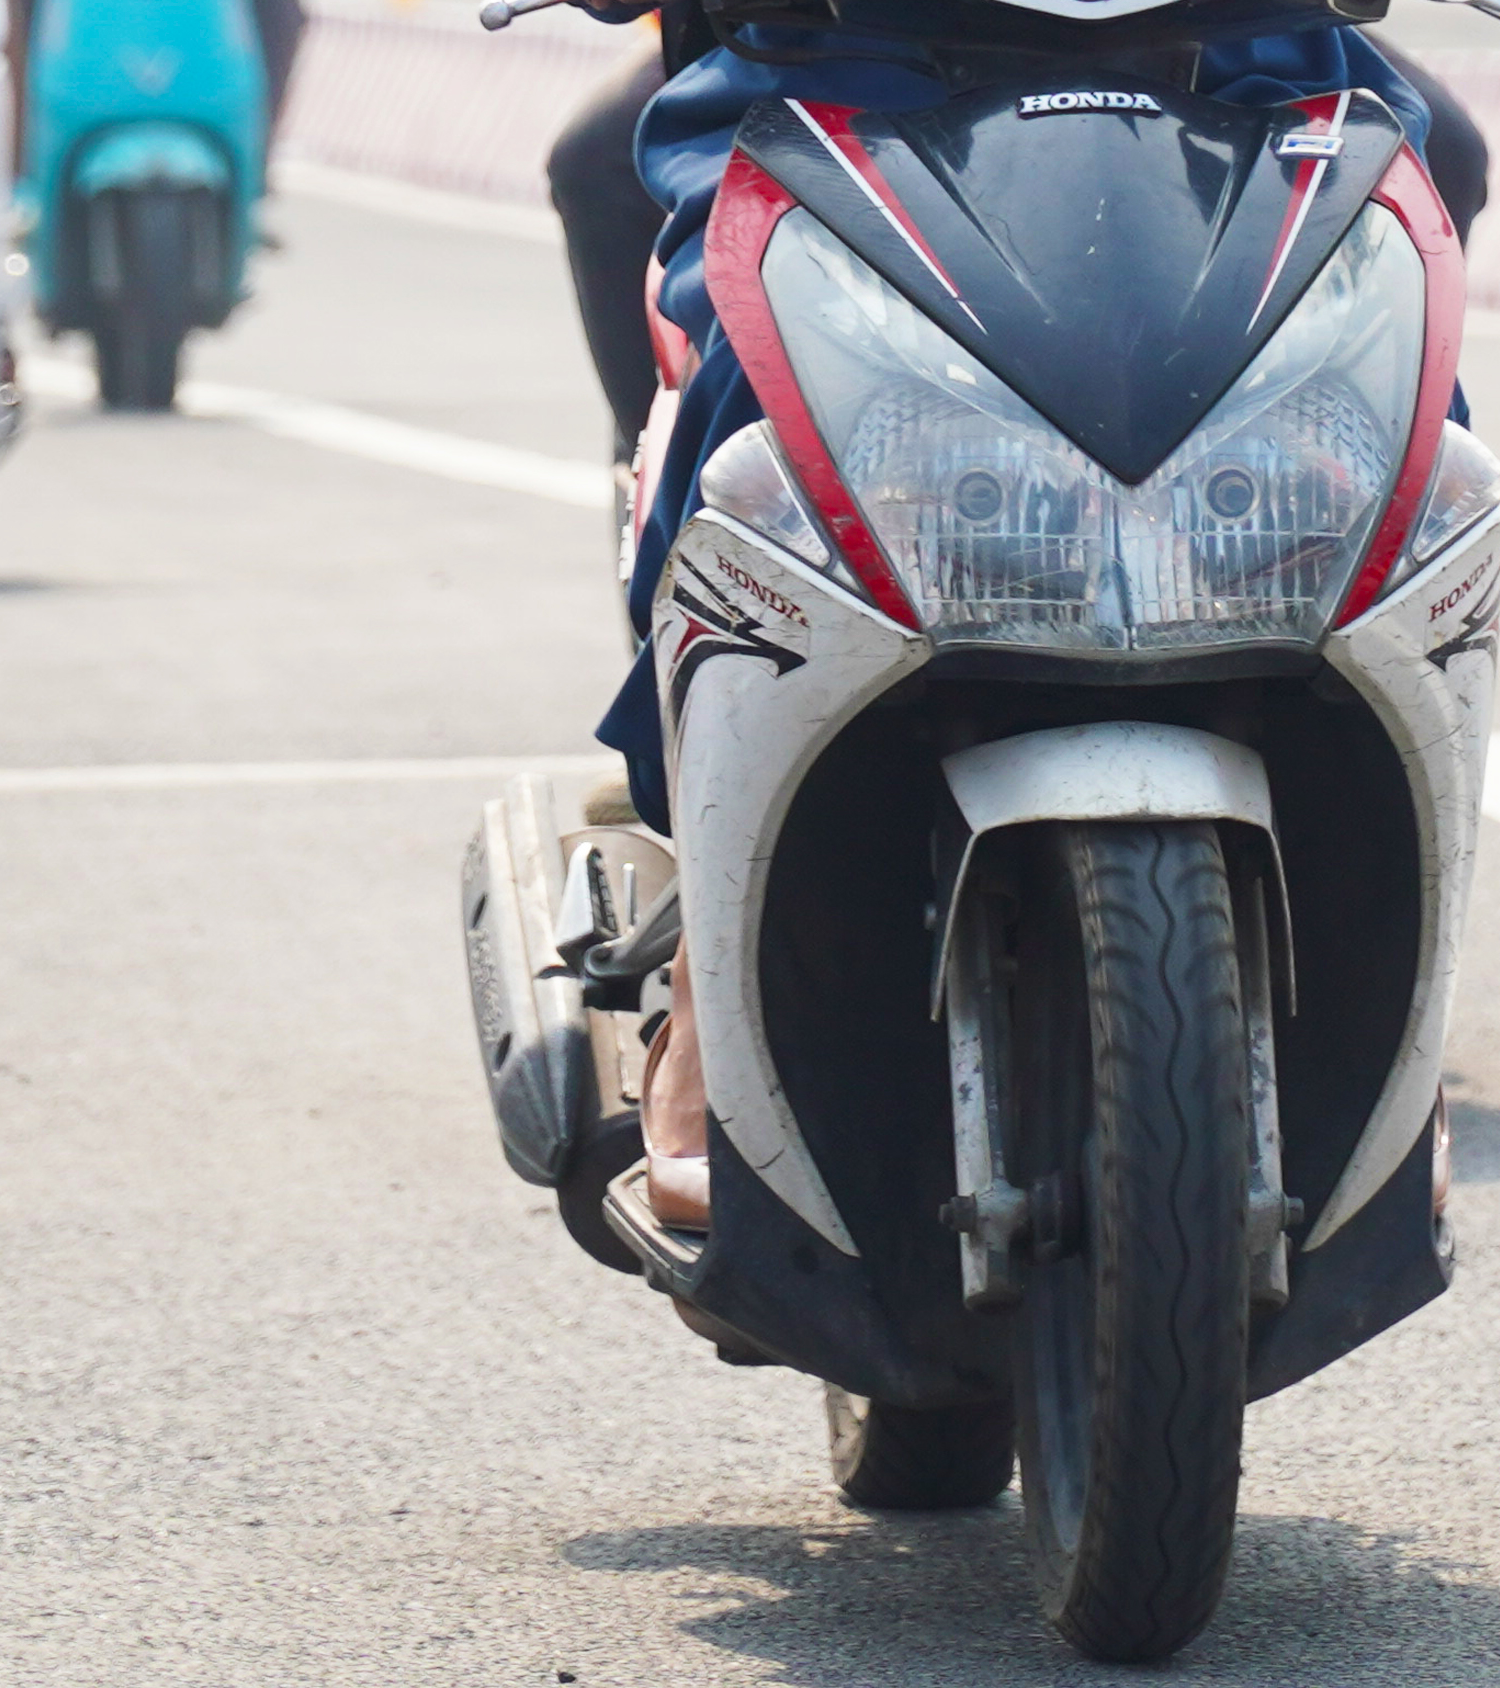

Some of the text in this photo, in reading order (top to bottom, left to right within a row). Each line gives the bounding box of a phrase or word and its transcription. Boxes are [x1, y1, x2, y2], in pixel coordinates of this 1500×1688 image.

[1020, 91, 1162, 114] HONDA
[714, 550, 810, 627] HONDA
[1428, 553, 1493, 623] HONDA
